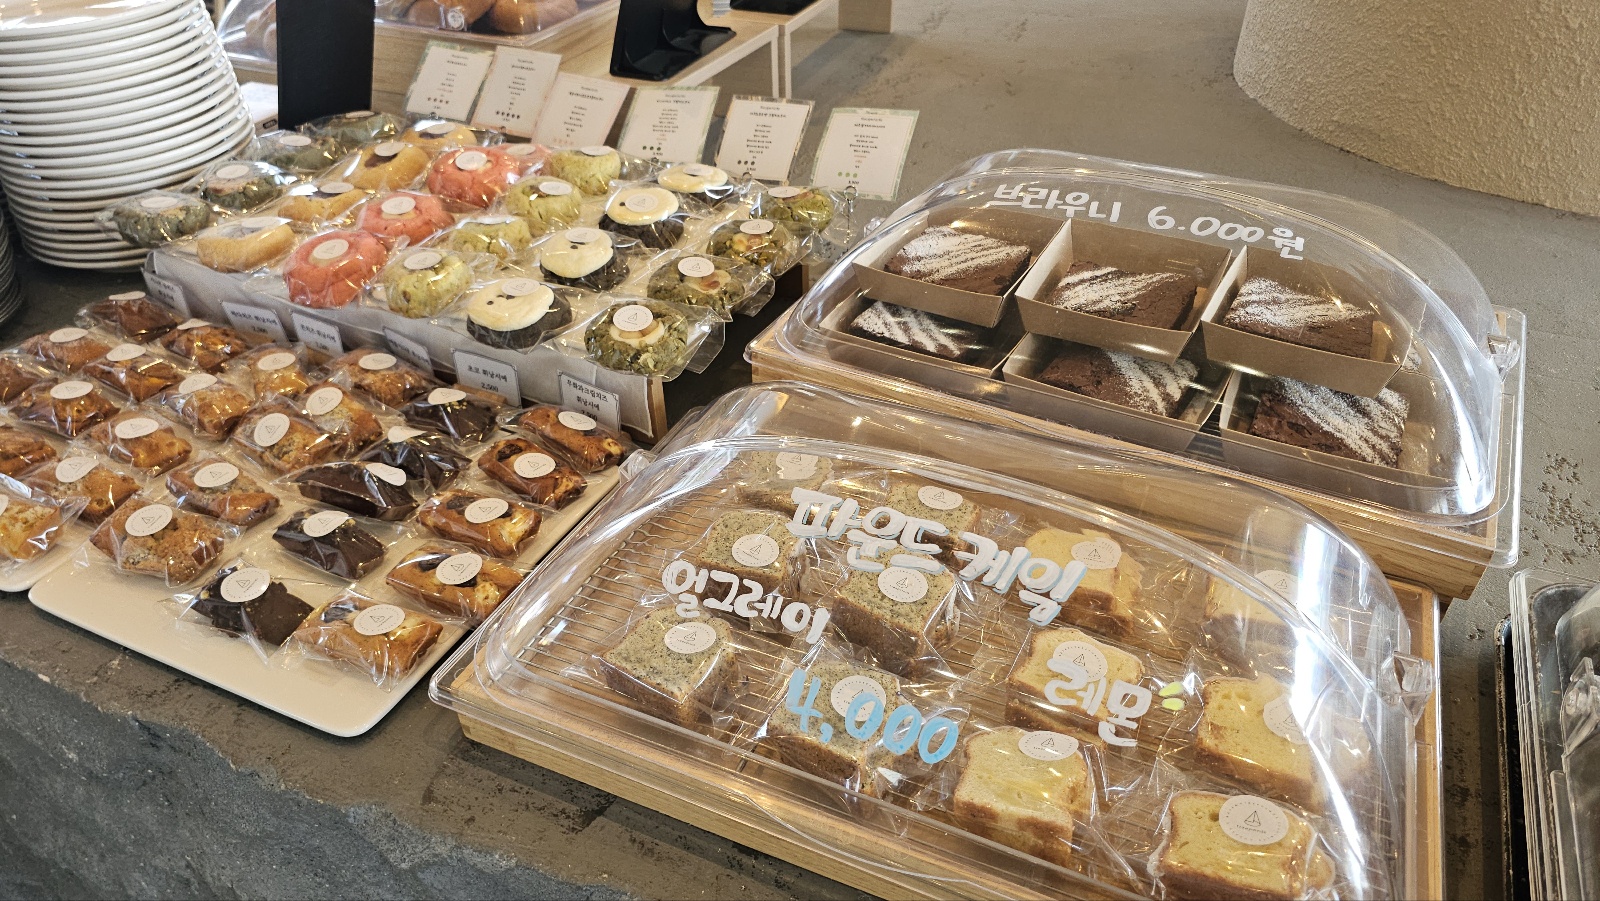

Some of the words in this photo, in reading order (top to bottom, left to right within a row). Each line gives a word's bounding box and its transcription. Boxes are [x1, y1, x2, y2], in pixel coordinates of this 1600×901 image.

[988, 183, 1122, 223] 브라우니
[482, 368, 508, 383] 휘낭시에
[576, 395, 600, 411] 휘낭시에
[785, 486, 950, 575] 파운드
[661, 559, 830, 644] 얼그레이
[786, 668, 960, 764] 4,000
[1044, 657, 1152, 747] 레몬
